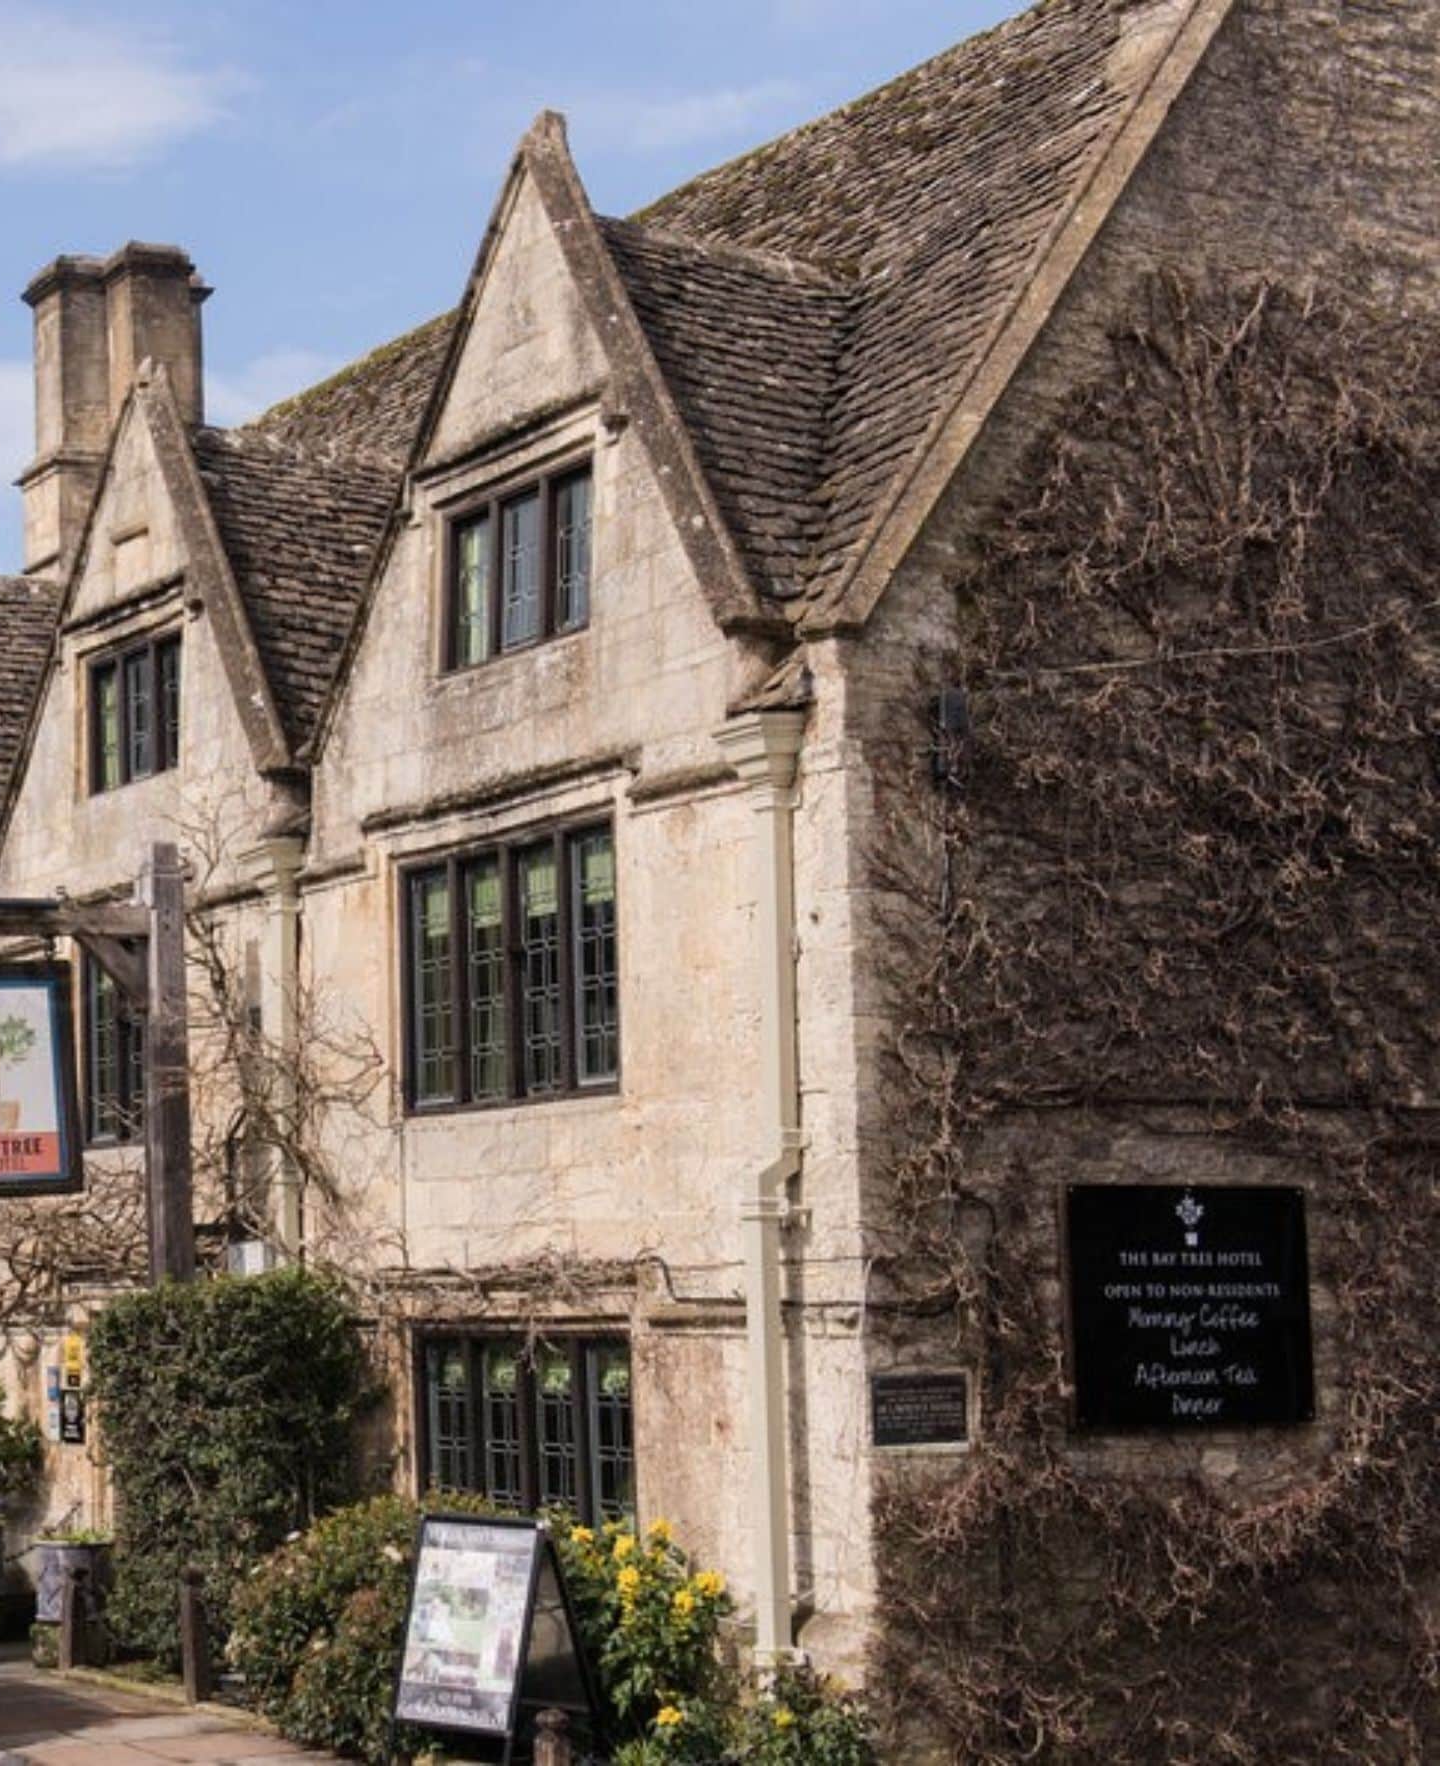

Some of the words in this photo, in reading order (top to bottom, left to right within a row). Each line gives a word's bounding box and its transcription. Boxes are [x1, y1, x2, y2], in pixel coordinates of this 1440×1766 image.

[0, 1138, 42, 1156] TREE
[1120, 1252, 1147, 1266] THE
[1152, 1252, 1176, 1266] BAY
[1181, 1252, 1212, 1266] TREE
[1217, 1252, 1262, 1266] HOTEL
[1104, 1284, 1142, 1298] OPEN
[1146, 1284, 1165, 1298] TO
[1200, 1304, 1259, 1330] Coffee
[1170, 1335, 1220, 1356] Lunch
[1135, 1362, 1219, 1388] Afternoon
[1222, 1363, 1257, 1384] Tea
